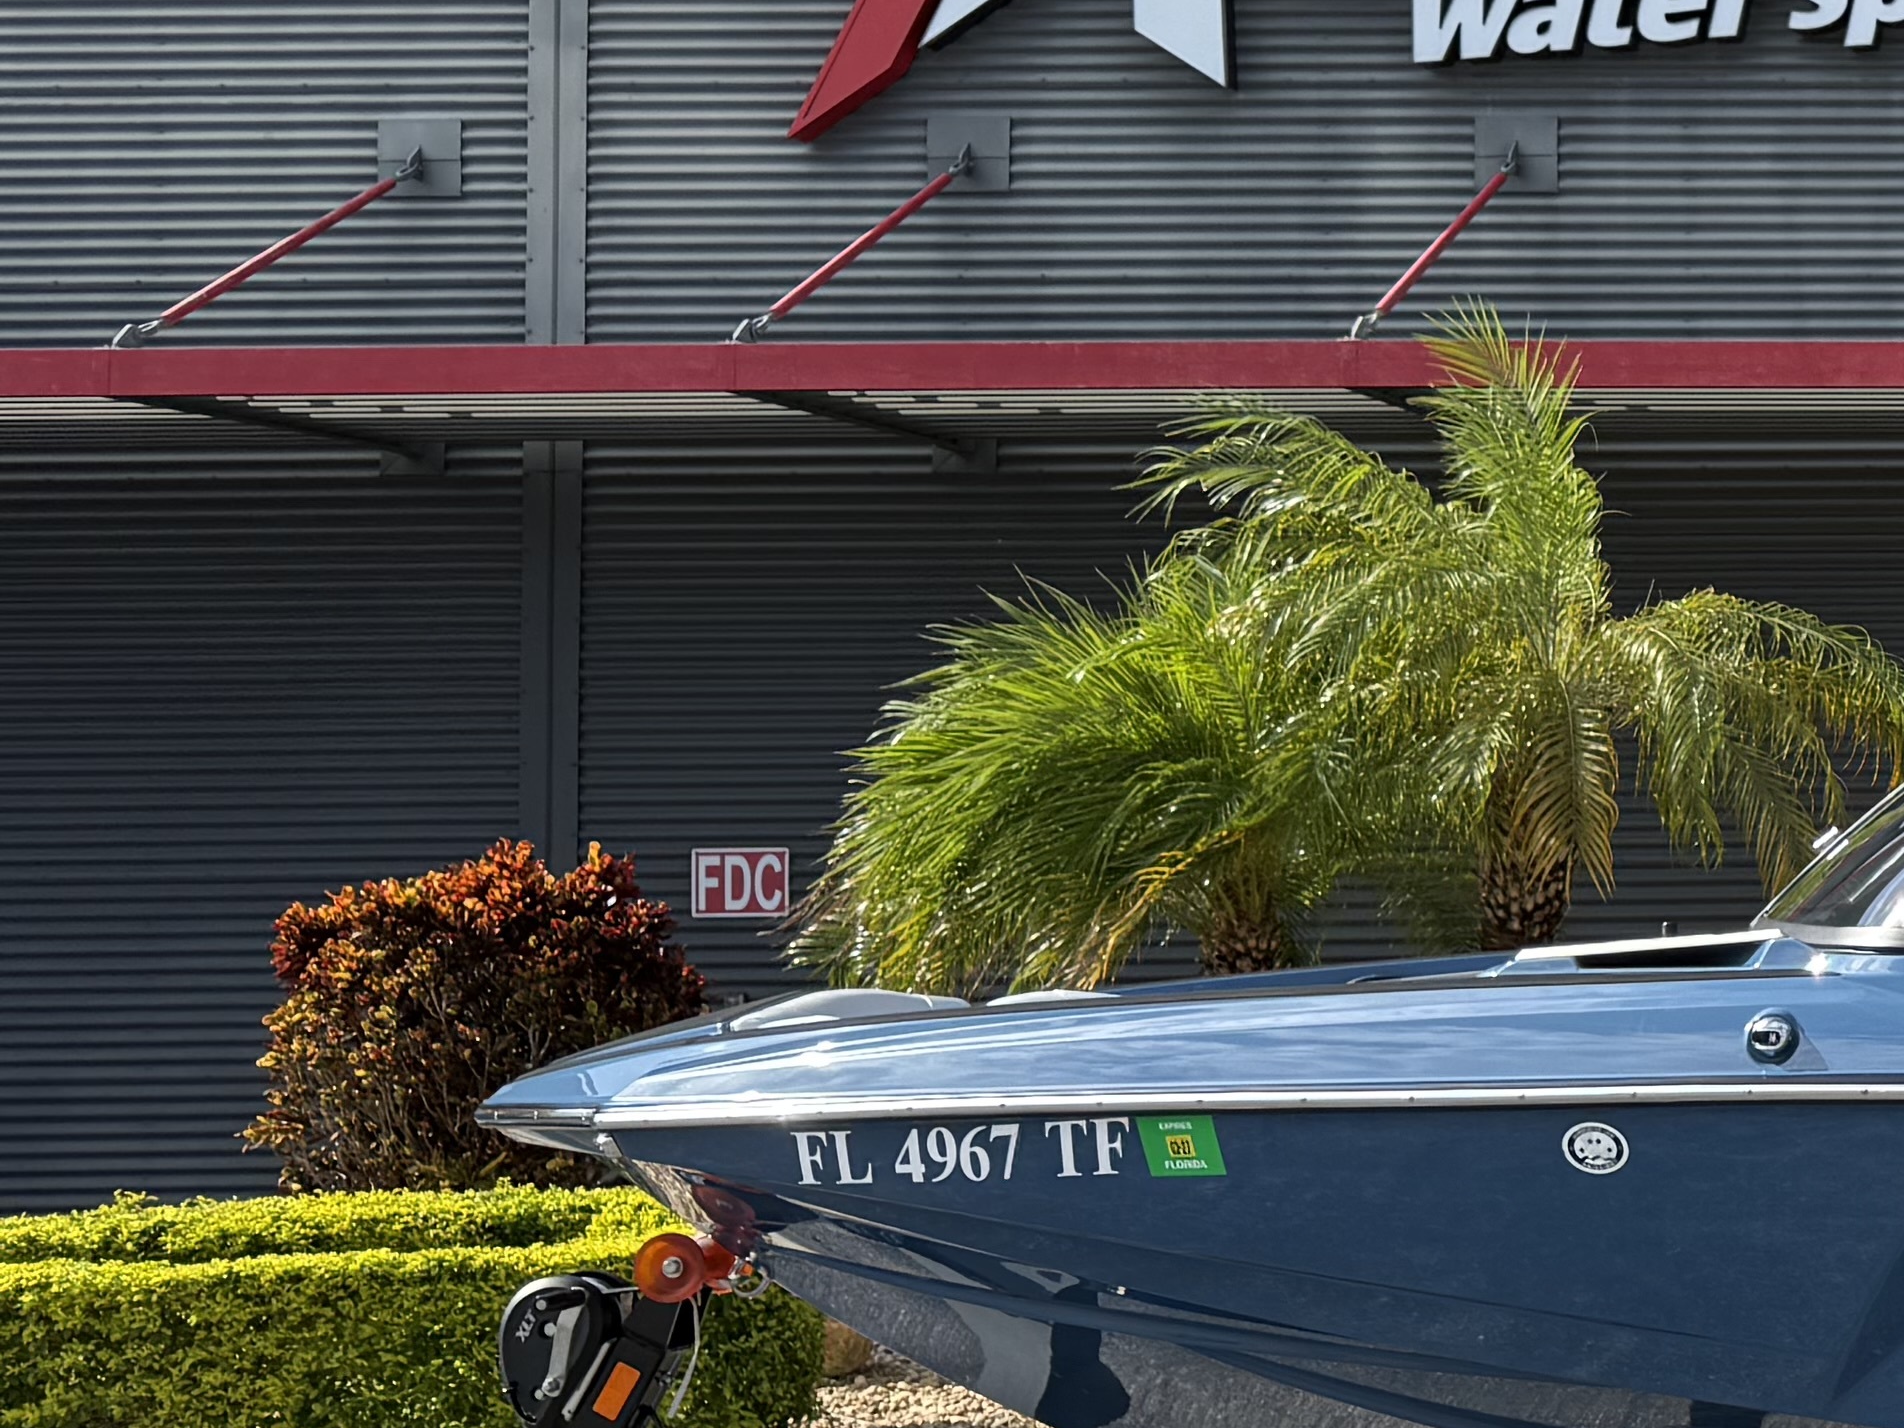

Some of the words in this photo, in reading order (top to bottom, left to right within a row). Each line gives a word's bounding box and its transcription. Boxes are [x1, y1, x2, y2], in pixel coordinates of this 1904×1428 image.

[698, 854, 783, 911] FDC
[790, 1130, 873, 1186] FL
[894, 1123, 1021, 1184] 4967
[1044, 1117, 1131, 1178] TF
[1164, 1159, 1208, 1170] FLORIDA
[514, 1307, 537, 1344] XLT
